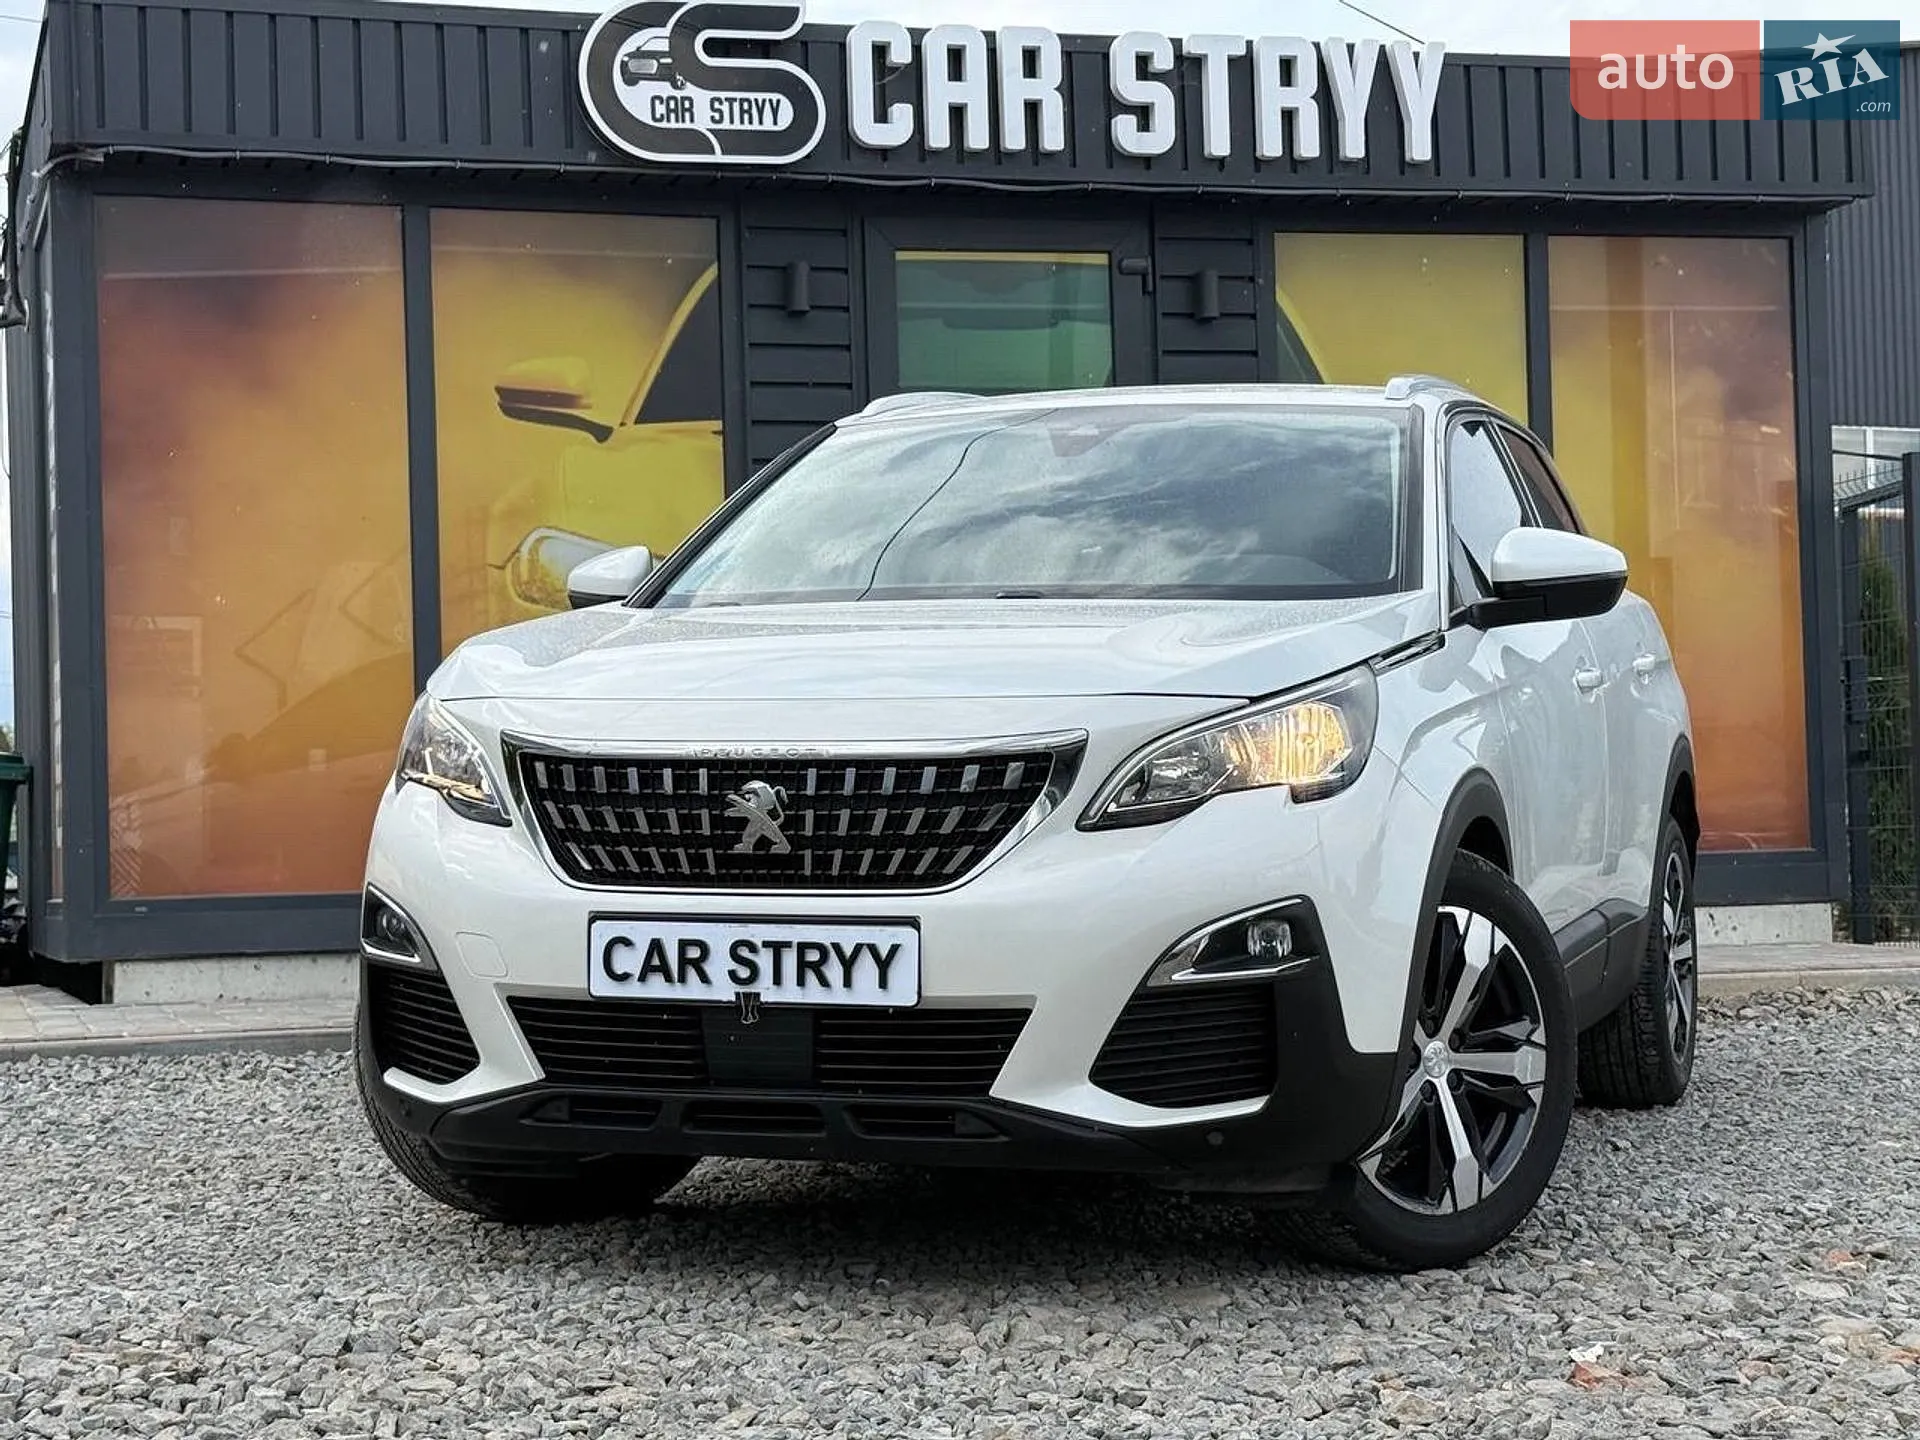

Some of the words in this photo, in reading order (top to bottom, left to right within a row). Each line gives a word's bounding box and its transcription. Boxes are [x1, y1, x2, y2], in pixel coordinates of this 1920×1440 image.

[651, 95, 695, 124] CAR
[709, 97, 781, 126] STRYY
[846, 20, 1065, 152] CAR
[1109, 30, 1446, 163] STRYY
[603, 936, 712, 984] CAR
[727, 939, 901, 989] STRYY
